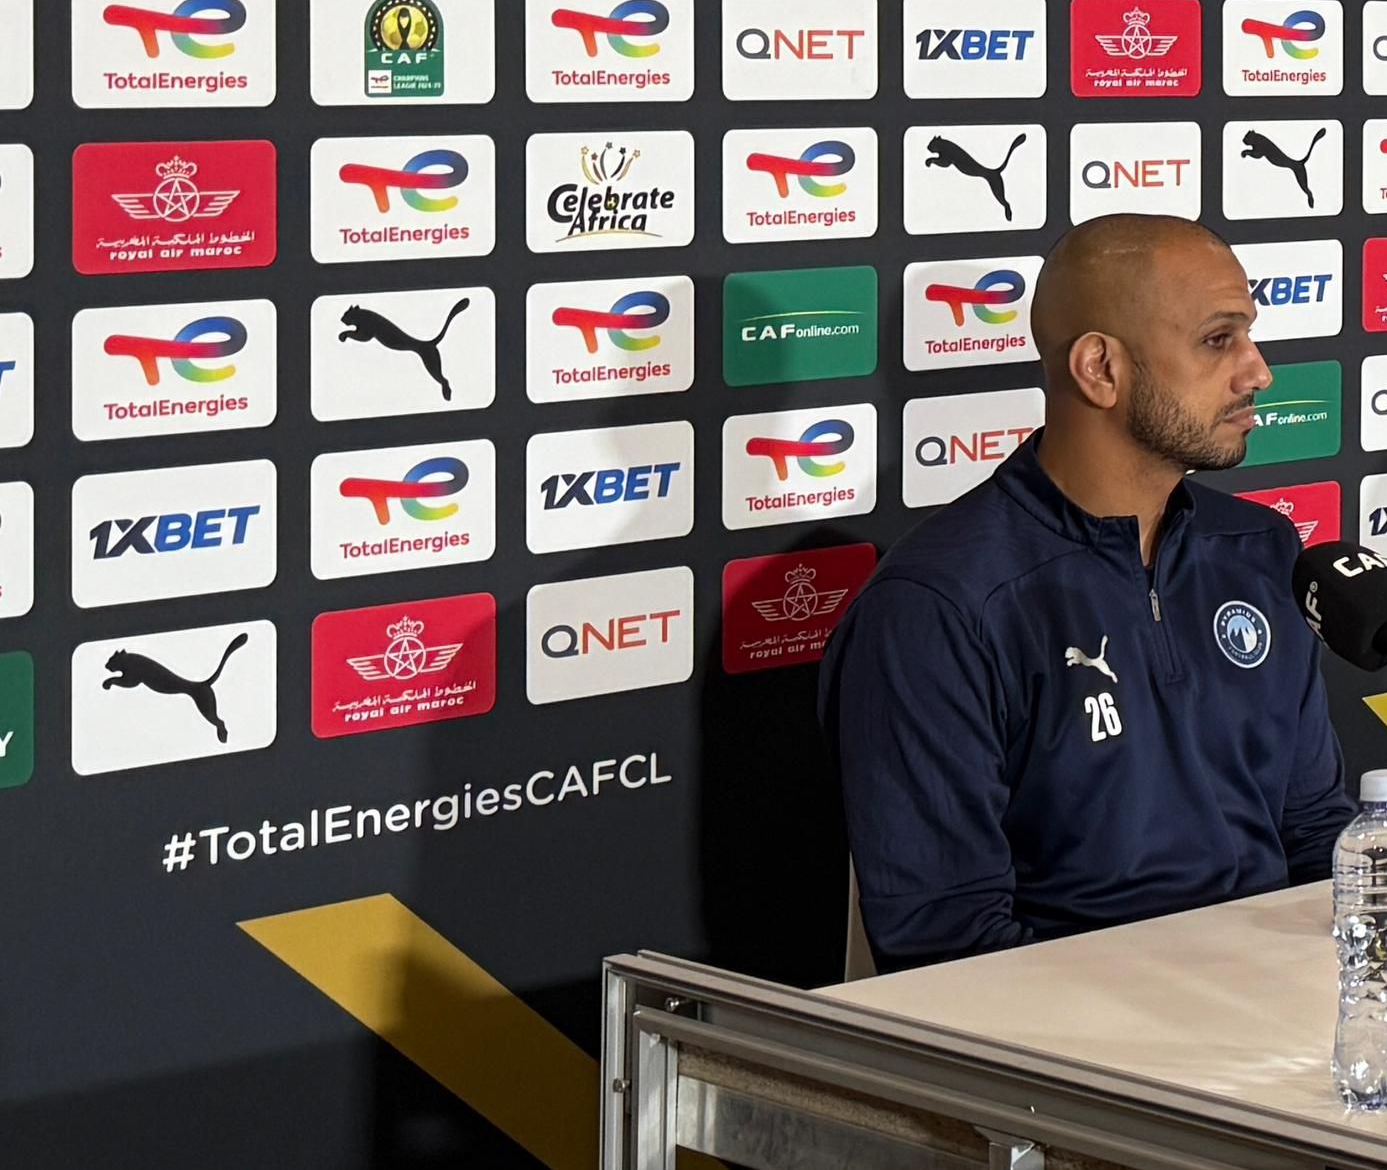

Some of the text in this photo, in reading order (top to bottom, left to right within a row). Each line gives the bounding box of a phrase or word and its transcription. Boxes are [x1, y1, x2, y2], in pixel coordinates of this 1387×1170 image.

[736, 28, 864, 59] QNET
[916, 29, 1034, 60] 1XBET
[381, 53, 427, 63] CAF
[104, 72, 247, 92] TotalEnergies
[552, 69, 670, 88] TotalEnergies
[1242, 69, 1326, 85] TotalEnergies
[1082, 160, 1190, 189] QNET
[547, 182, 674, 223] Celebrate
[567, 209, 647, 235] Africa
[746, 208, 855, 226] TotalEnergies
[339, 224, 469, 244] TotalEnergies
[110, 246, 241, 260] royal air maroc
[1248, 273, 1332, 306] XBET
[742, 321, 859, 341] CAFonline.com
[925, 334, 1025, 353] TotalEnergies
[552, 361, 670, 384] TotalEnergies
[104, 394, 248, 420] TotalEnergies
[1253, 413, 1327, 426] AFonline.com
[916, 428, 1034, 467] QNET
[541, 462, 680, 510] 1XBET
[746, 487, 854, 511] TotalEnergies
[90, 506, 260, 559] 1XBET
[340, 531, 469, 558] TotalEnergies
[1306, 591, 1326, 642] AF
[541, 610, 680, 658] QNET
[750, 647, 782, 659] royal
[788, 644, 805, 652] air
[345, 697, 463, 721] royal air maroc
[1085, 693, 1122, 743] 26
[162, 753, 671, 872] #TotalEnergiesCAFCL
